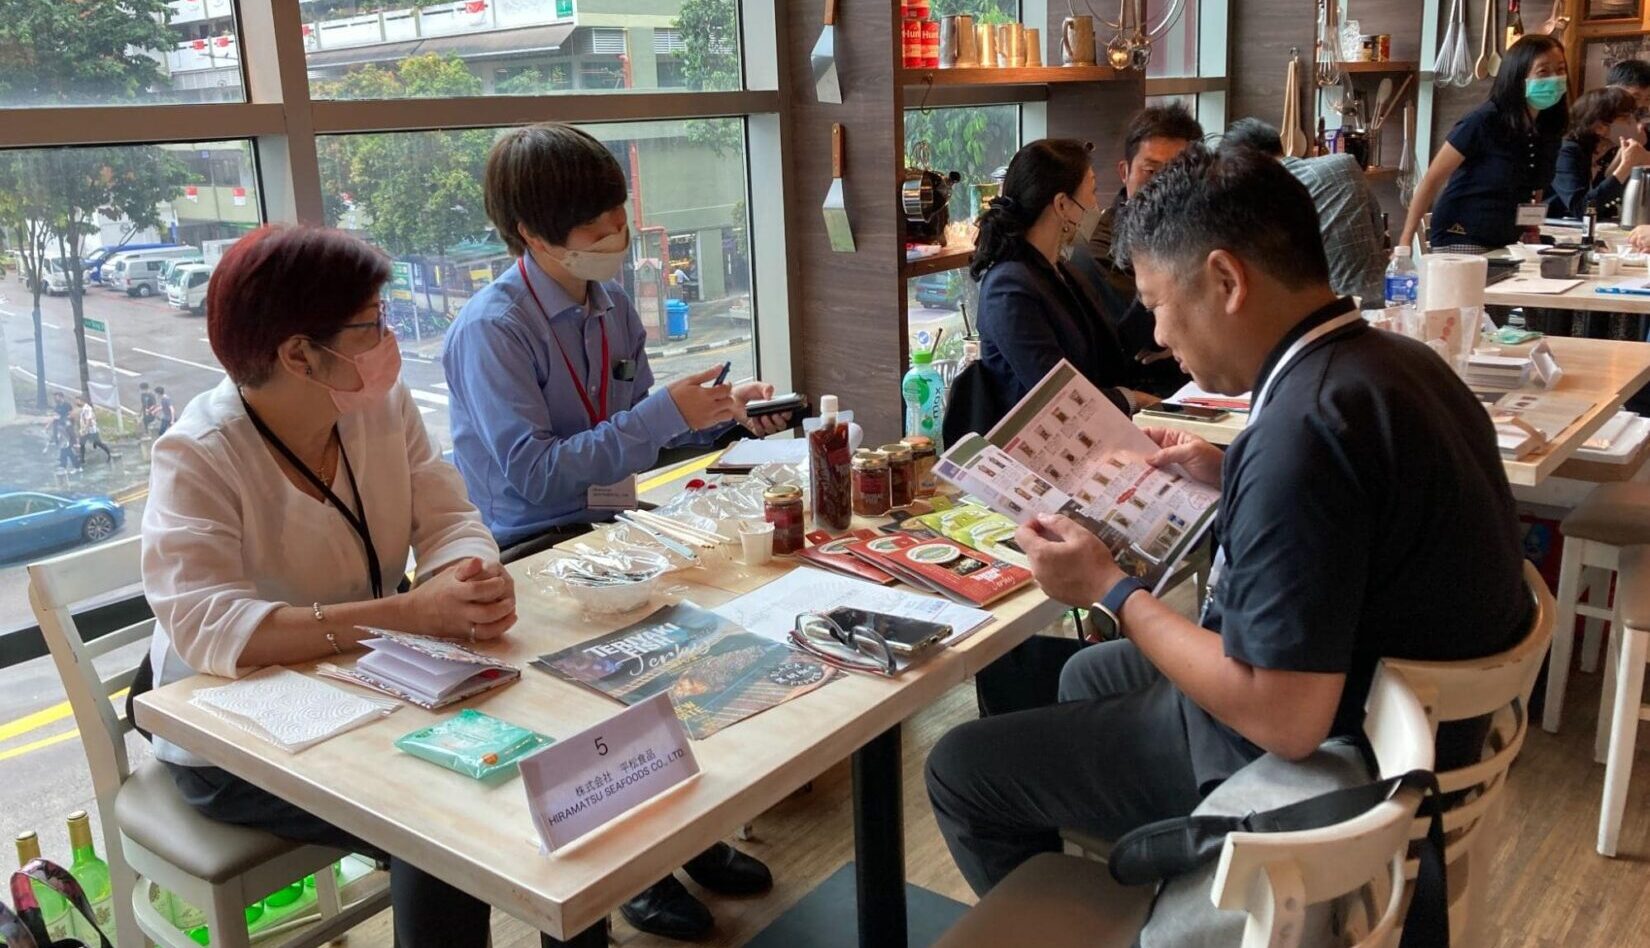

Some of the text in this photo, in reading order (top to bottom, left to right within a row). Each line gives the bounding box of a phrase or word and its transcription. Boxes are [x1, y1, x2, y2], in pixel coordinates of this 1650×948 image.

[933, 387, 941, 419] max
[582, 622, 680, 657] TERIYAKI
[594, 736, 609, 756] 5
[548, 792, 604, 826] HIRAMATSU
[605, 768, 650, 796] SEAFOODS
[575, 771, 614, 797] 株式会社
